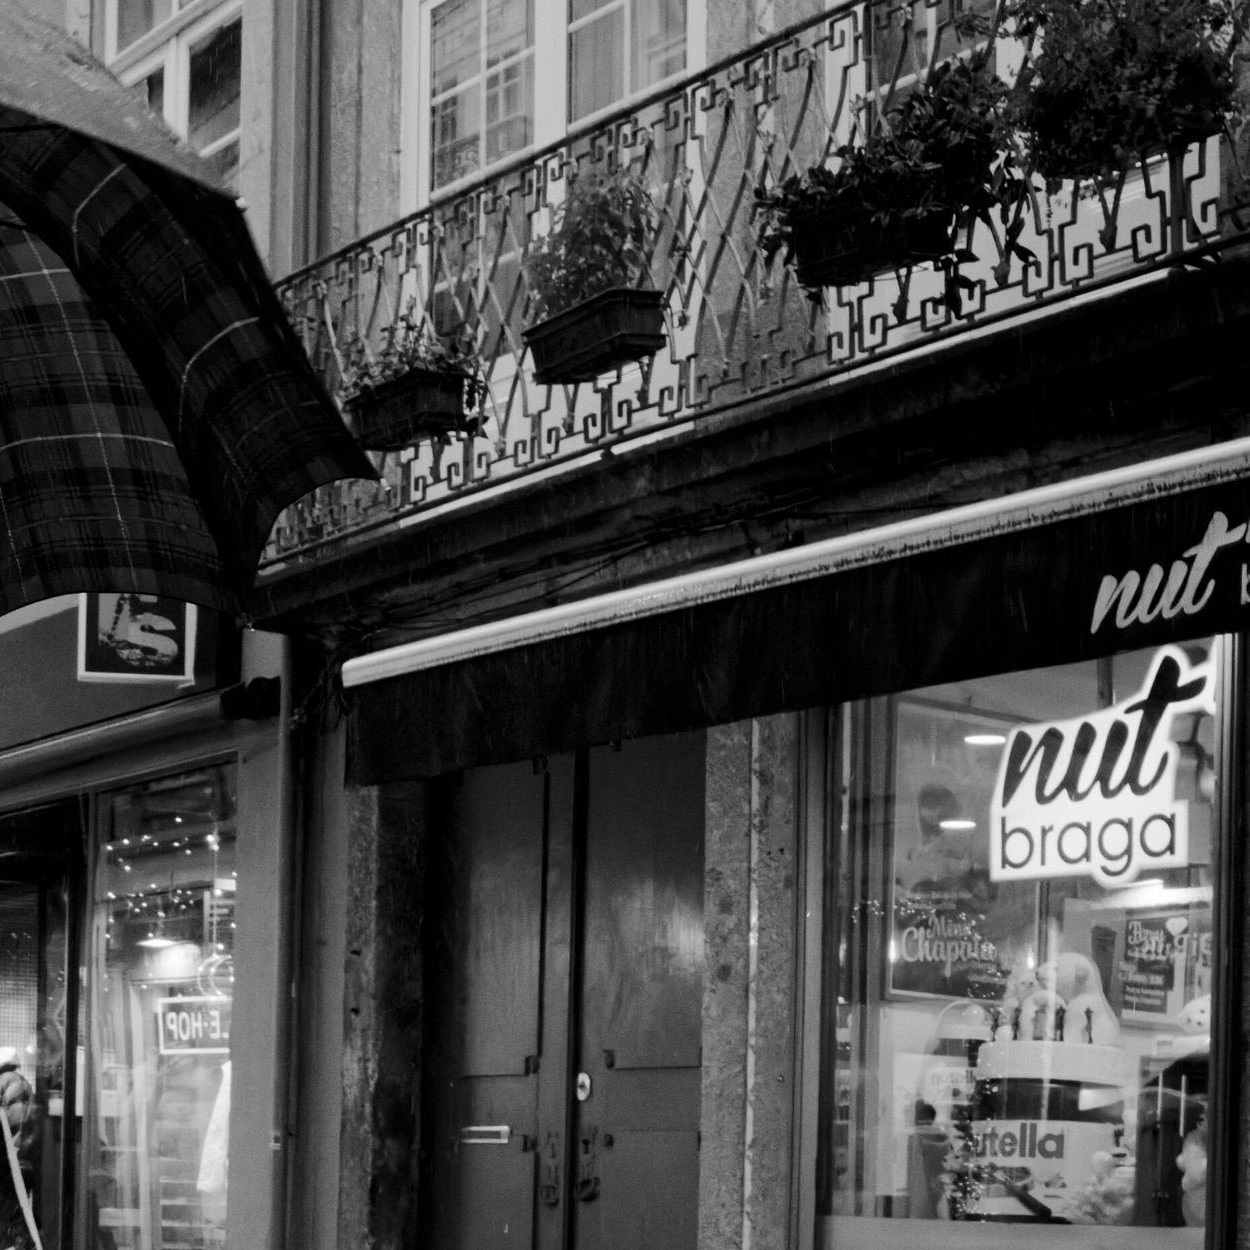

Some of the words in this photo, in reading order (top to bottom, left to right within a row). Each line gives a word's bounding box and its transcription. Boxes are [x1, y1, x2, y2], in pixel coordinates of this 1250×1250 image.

[1090, 510, 1247, 634] nut
[1002, 655, 1207, 808] nut
[1001, 813, 1176, 876] braga
[972, 1122, 1065, 1159] utella
